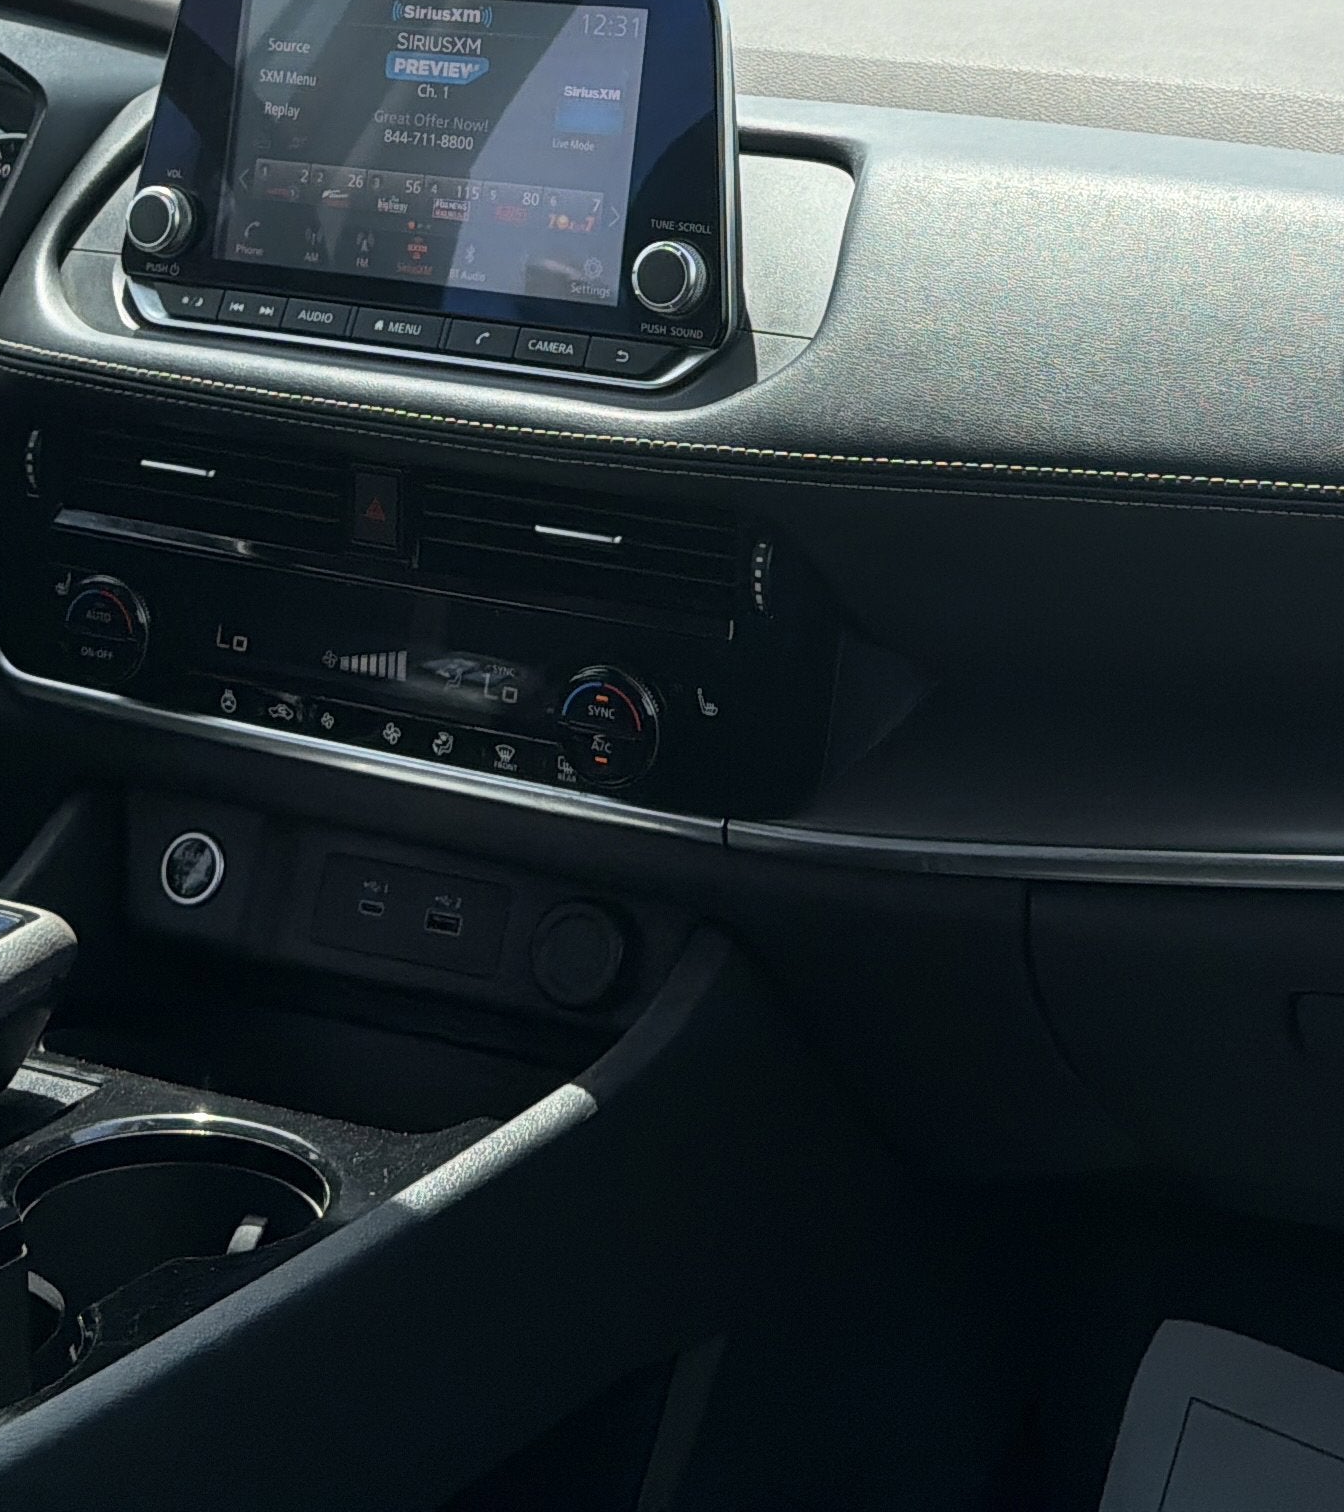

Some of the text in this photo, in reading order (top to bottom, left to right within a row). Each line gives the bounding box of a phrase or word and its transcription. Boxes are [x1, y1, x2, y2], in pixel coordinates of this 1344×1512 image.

[581, 14, 641, 39] 12:31
[268, 38, 311, 54] Source
[397, 32, 482, 55] SIRIUSXM
[260, 69, 317, 87] SXM Menu
[417, 84, 438, 99] Ch.
[564, 85, 621, 101] SiriusXM
[264, 101, 301, 121] Replay
[374, 110, 489, 132] Great Offer Now!
[384, 128, 474, 151] 844-711-8800
[570, 139, 595, 153] Mode
[167, 168, 183, 178] VOL
[300, 169, 309, 183] 2
[348, 174, 364, 189] 26
[405, 179, 422, 194] 56
[457, 185, 480, 200] 115
[522, 191, 540, 206] 80
[592, 199, 601, 213] 7
[460, 270, 486, 282] Audio
[571, 282, 611, 300] Settings
[298, 309, 333, 323] AUDIO
[387, 320, 422, 335] MENU
[641, 323, 704, 339] PUSH SOUND
[528, 339, 574, 355] CAMERA
[86, 609, 112, 624] AUTO
[587, 705, 615, 720] SYNC
